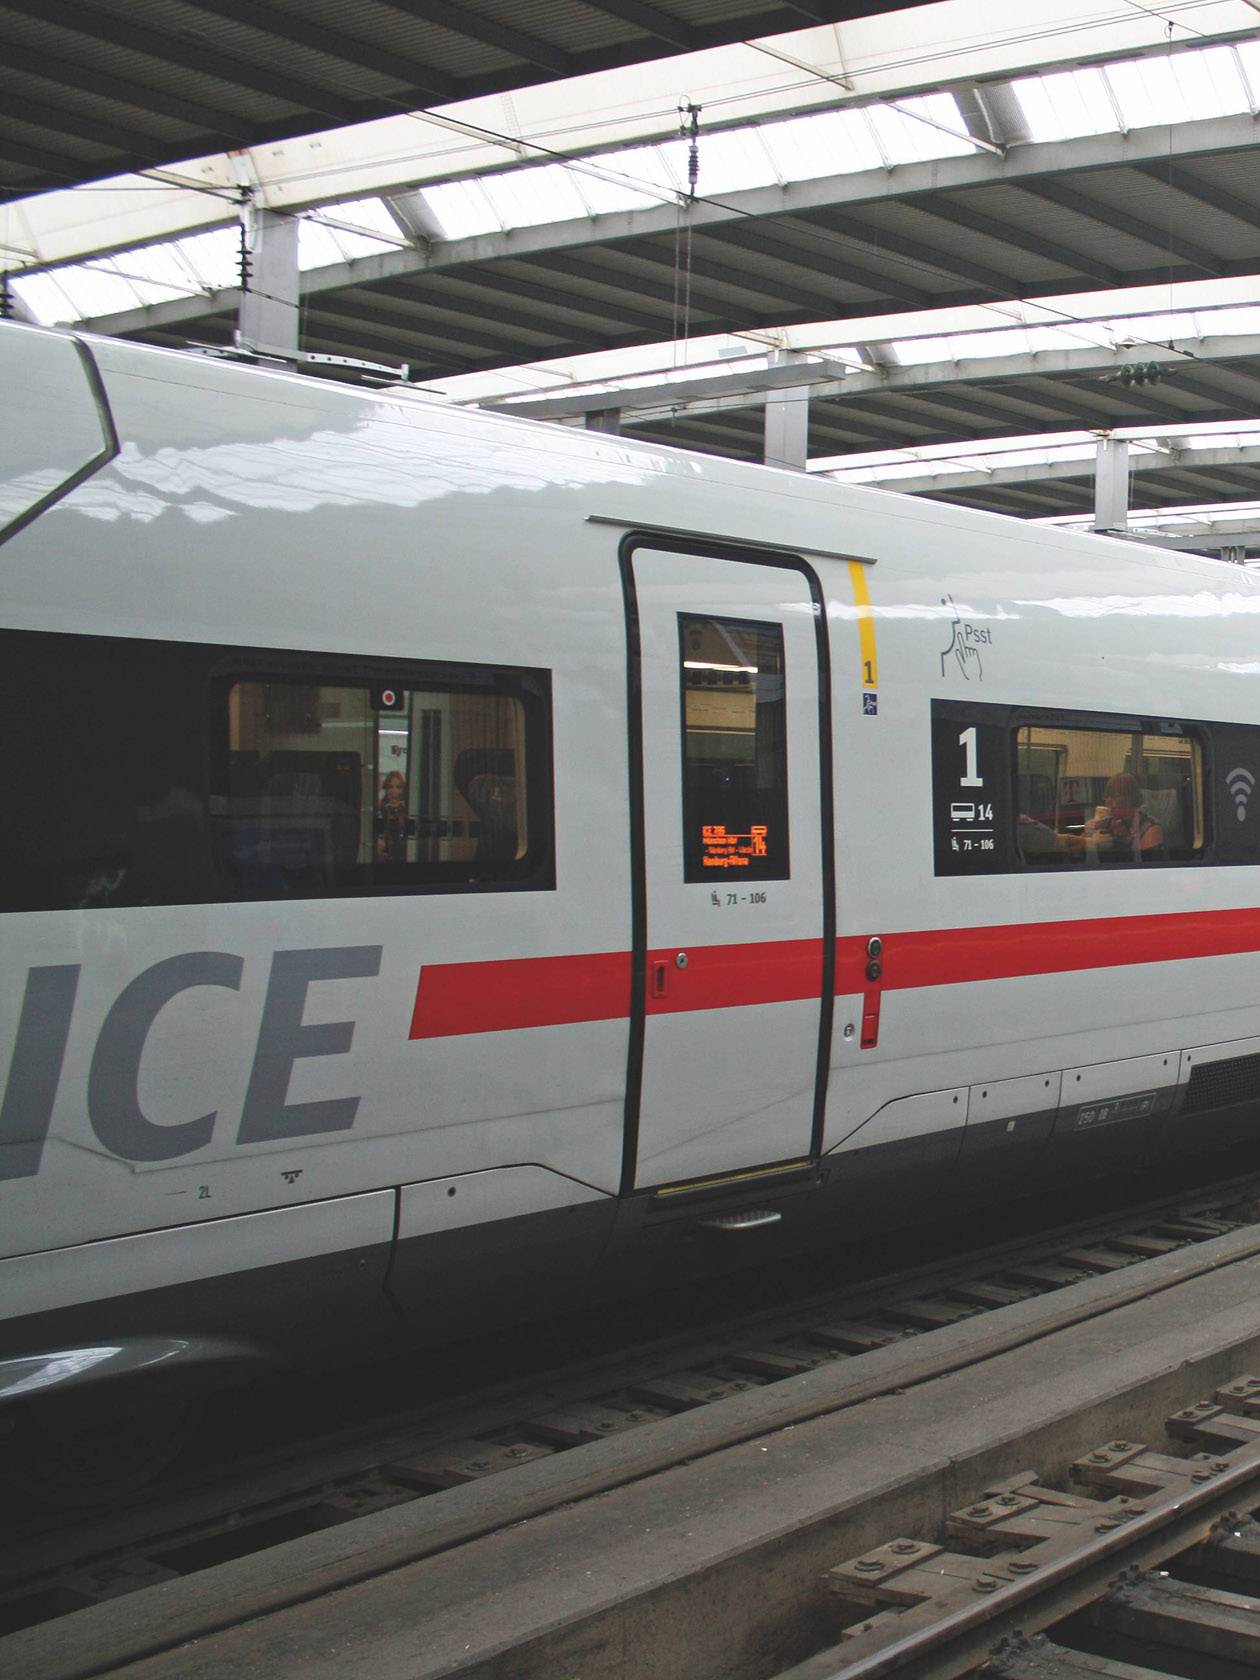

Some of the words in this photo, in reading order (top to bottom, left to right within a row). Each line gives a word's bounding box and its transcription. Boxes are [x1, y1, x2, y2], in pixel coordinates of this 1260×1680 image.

[964, 624, 993, 644] Psst
[864, 660, 875, 684] 1
[958, 727, 984, 787] 1
[978, 803, 994, 821] 14
[963, 839, 973, 850] 71
[980, 838, 994, 850] 106
[726, 893, 738, 906] 71
[749, 891, 767, 905] 106
[0, 945, 384, 1182] ICE
